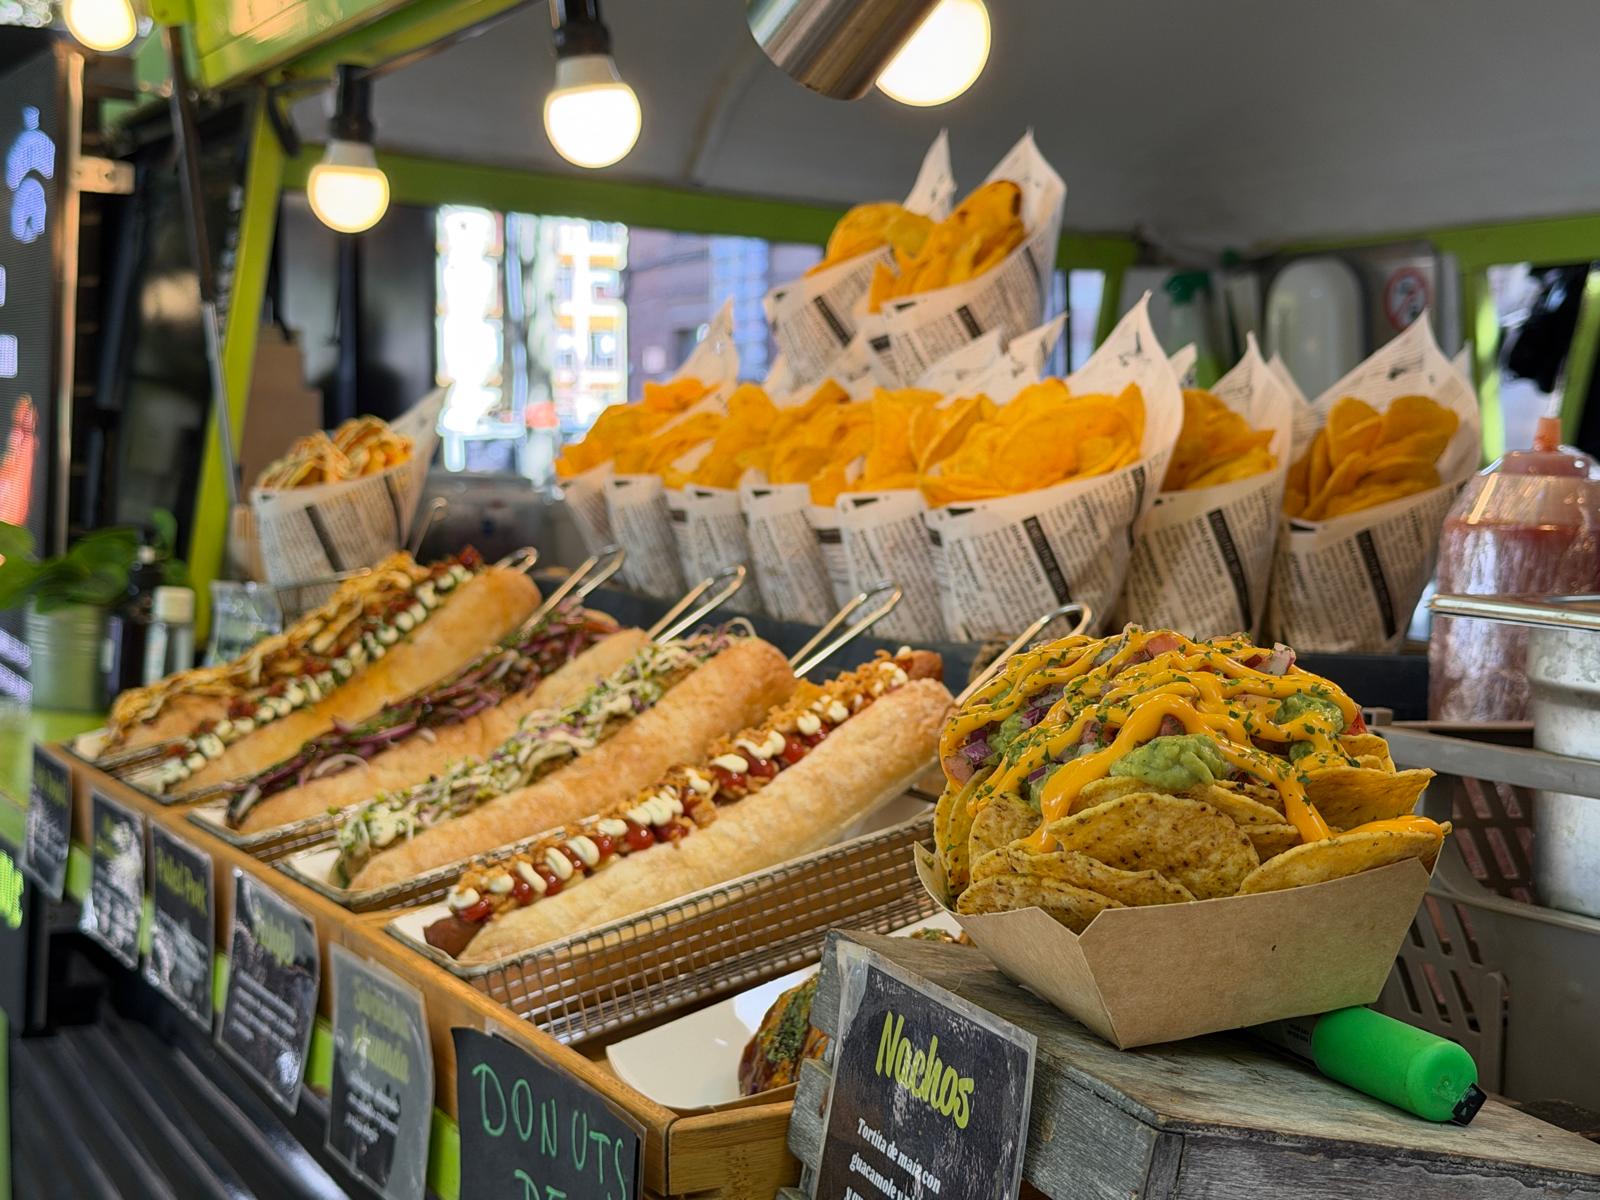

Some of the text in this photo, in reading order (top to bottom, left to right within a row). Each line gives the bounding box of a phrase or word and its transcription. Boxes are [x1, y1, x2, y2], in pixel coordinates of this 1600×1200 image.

[875, 1010, 974, 1129] Nachos
[849, 1152, 897, 1200] guacamole
[857, 1117, 888, 1154] Tortita
[887, 1140, 899, 1162] de
[922, 1170, 941, 1194] con
